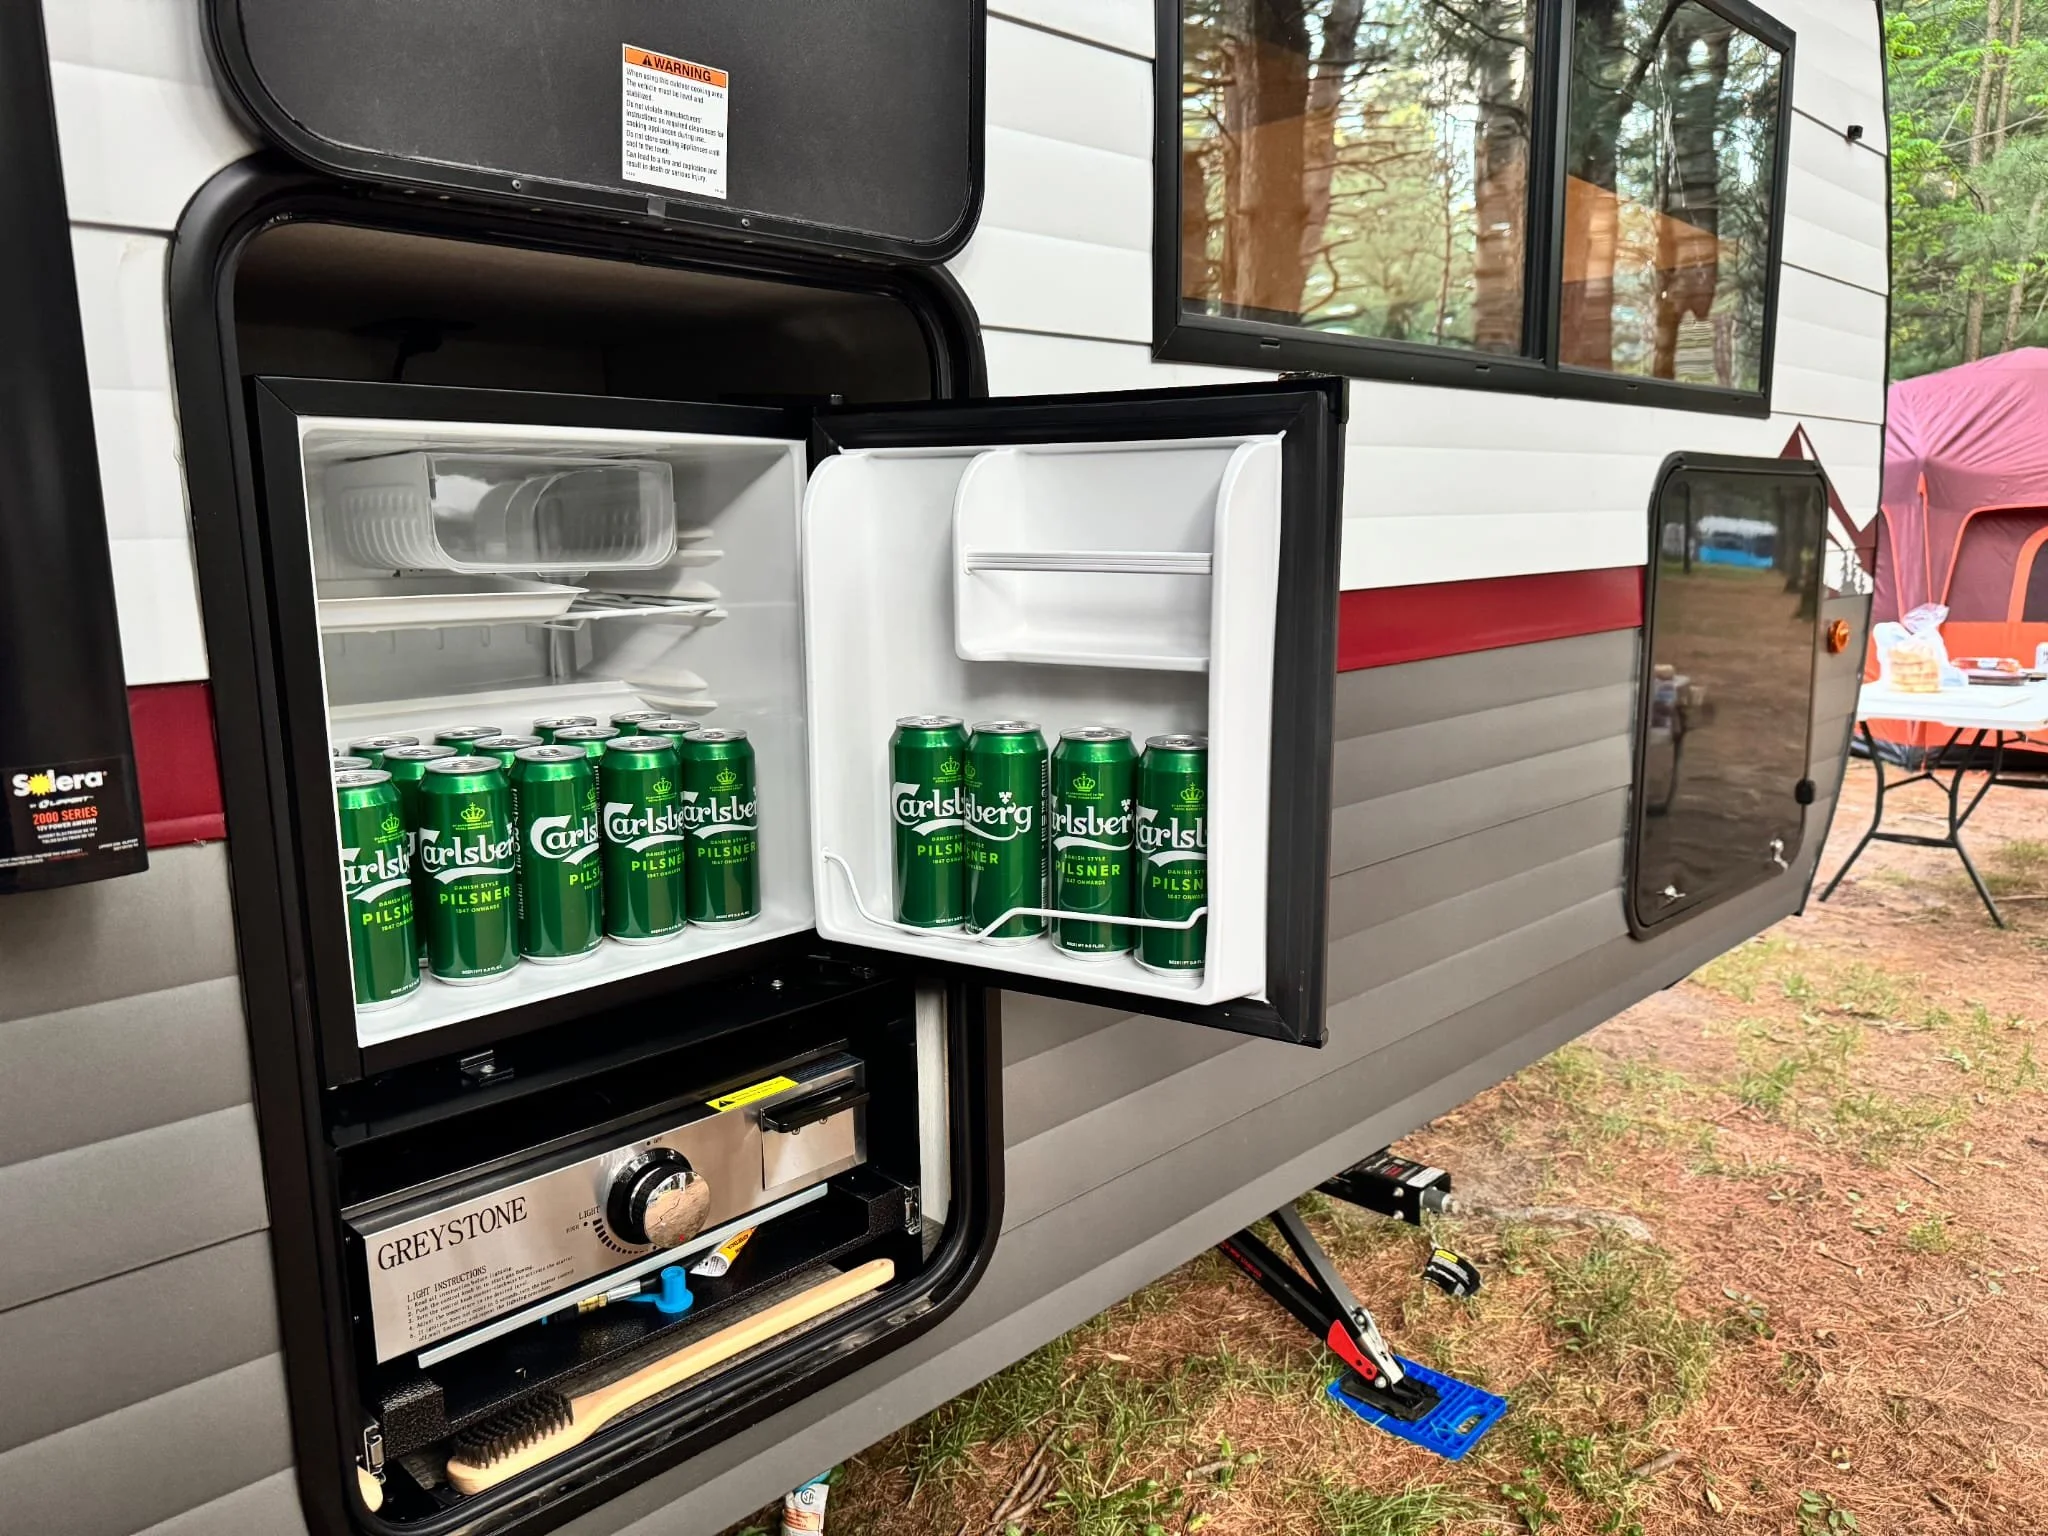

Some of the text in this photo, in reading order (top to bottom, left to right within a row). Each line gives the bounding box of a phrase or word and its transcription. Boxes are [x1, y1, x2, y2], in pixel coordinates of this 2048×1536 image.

[654, 56, 711, 82] WARNING
[680, 791, 757, 829] Carlsber
[892, 782, 963, 825] Carlsb
[964, 793, 1033, 833] sberg
[33, 806, 98, 825] 2000 SERIES
[604, 802, 684, 843] Carlsbe
[530, 814, 598, 859] Carls
[1136, 803, 1207, 853] Carlsb
[419, 827, 515, 873] Carlsber
[698, 841, 756, 858] PILSNER
[917, 842, 962, 856] PILSN
[632, 852, 684, 871] PILSNE
[1055, 861, 1120, 877] PILSNER
[481, 880, 499, 888] STYLE
[569, 866, 600, 885] PILS
[1152, 876, 1204, 891] PILSN
[440, 886, 511, 905] PILSNER
[579, 1205, 601, 1220] LIGHT
[378, 1197, 528, 1270] GREYSTONE
[407, 1264, 487, 1302] LIGHT INSTRUCTIONS
